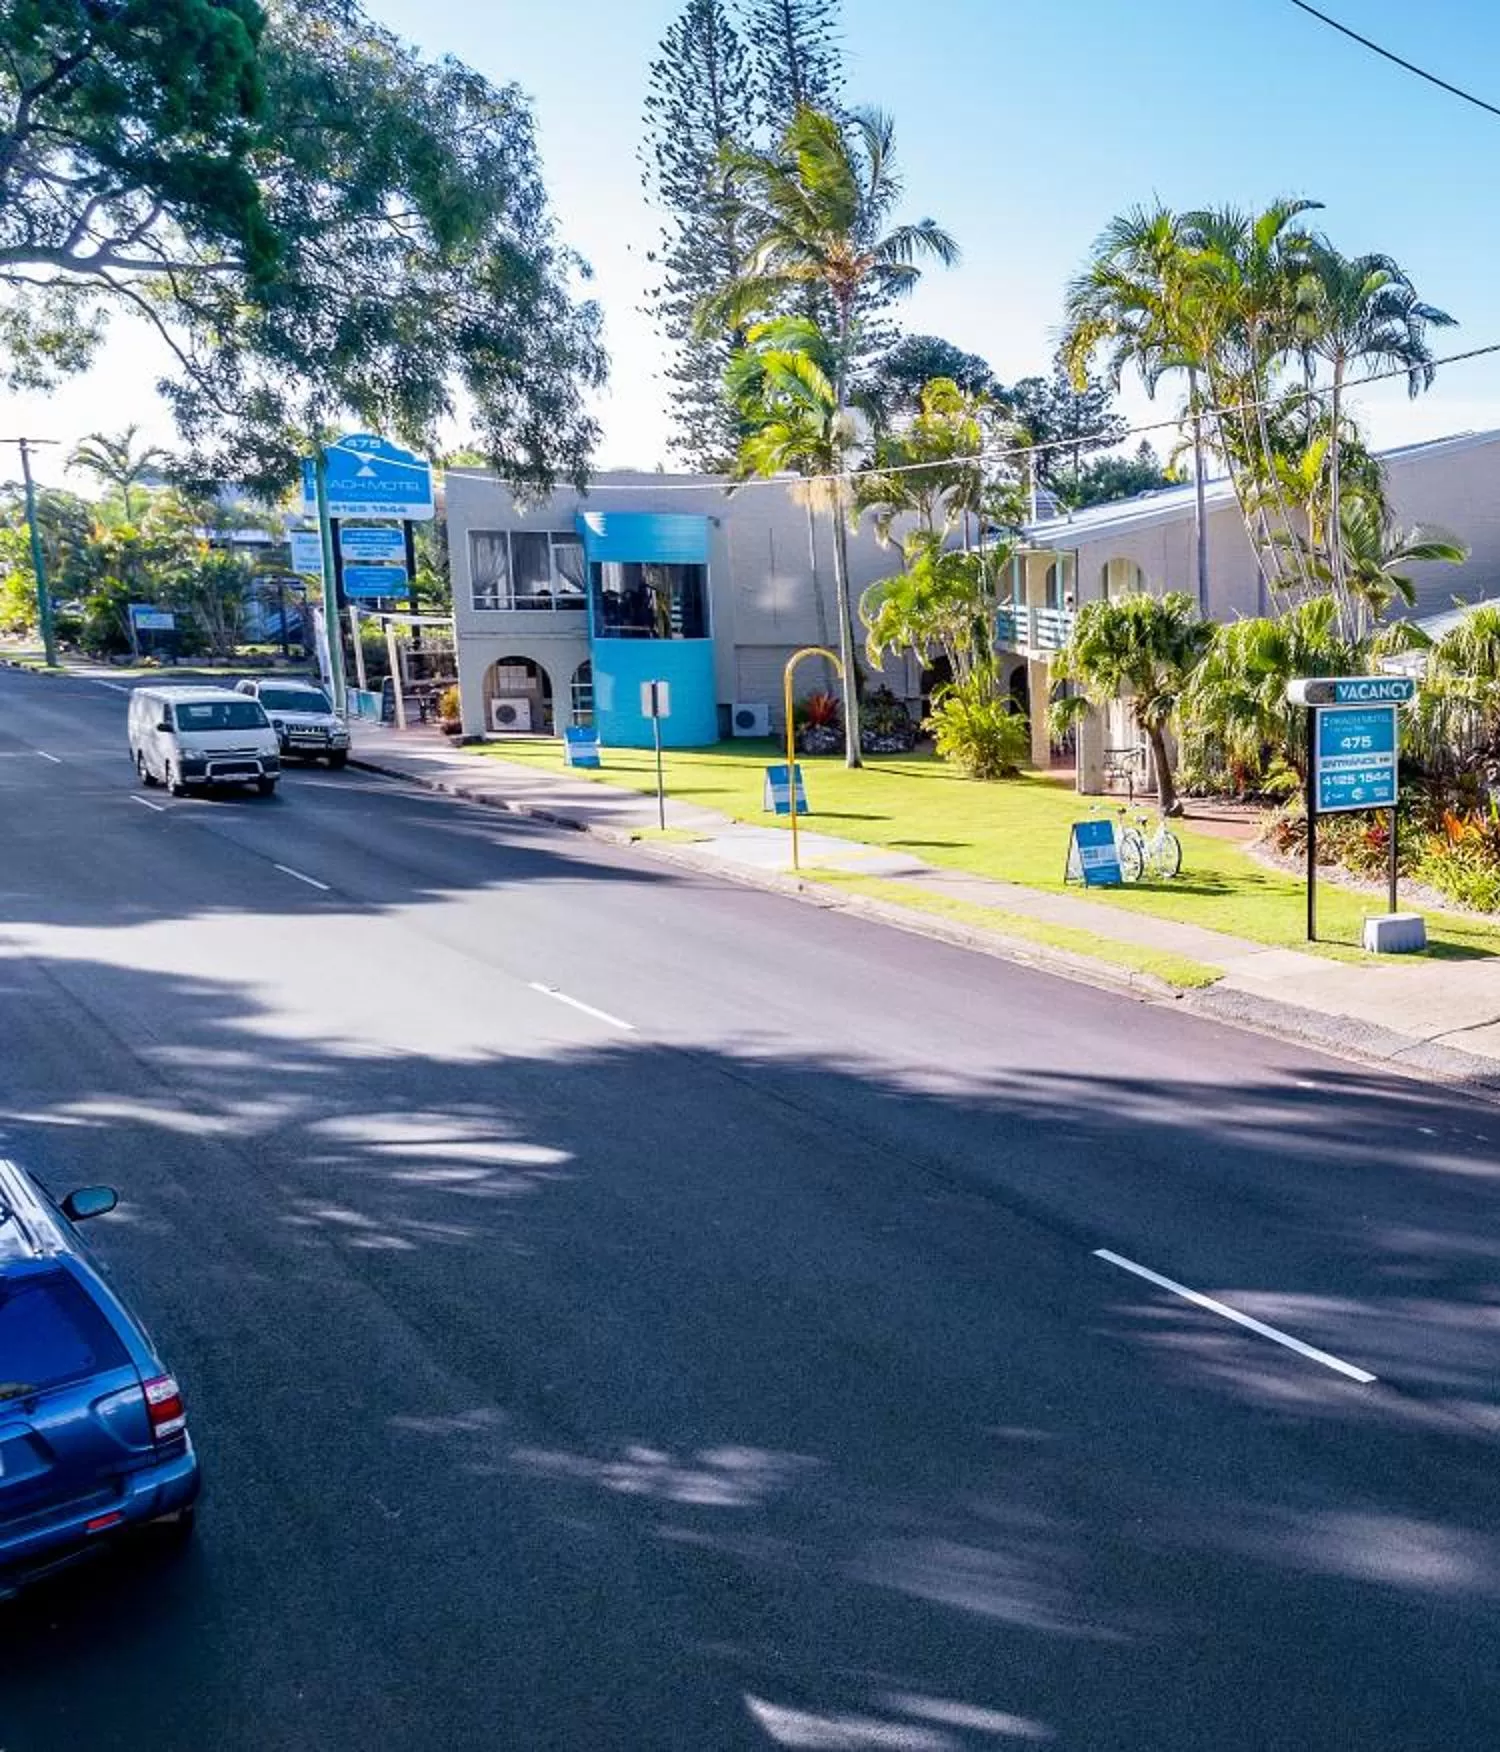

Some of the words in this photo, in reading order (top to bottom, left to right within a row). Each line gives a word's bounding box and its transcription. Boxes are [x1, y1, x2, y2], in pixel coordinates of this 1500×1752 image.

[345, 439, 382, 449] 475
[368, 481, 420, 491] MOTEL
[1338, 682, 1410, 700] VACANCY
[1341, 735, 1373, 749] 475
